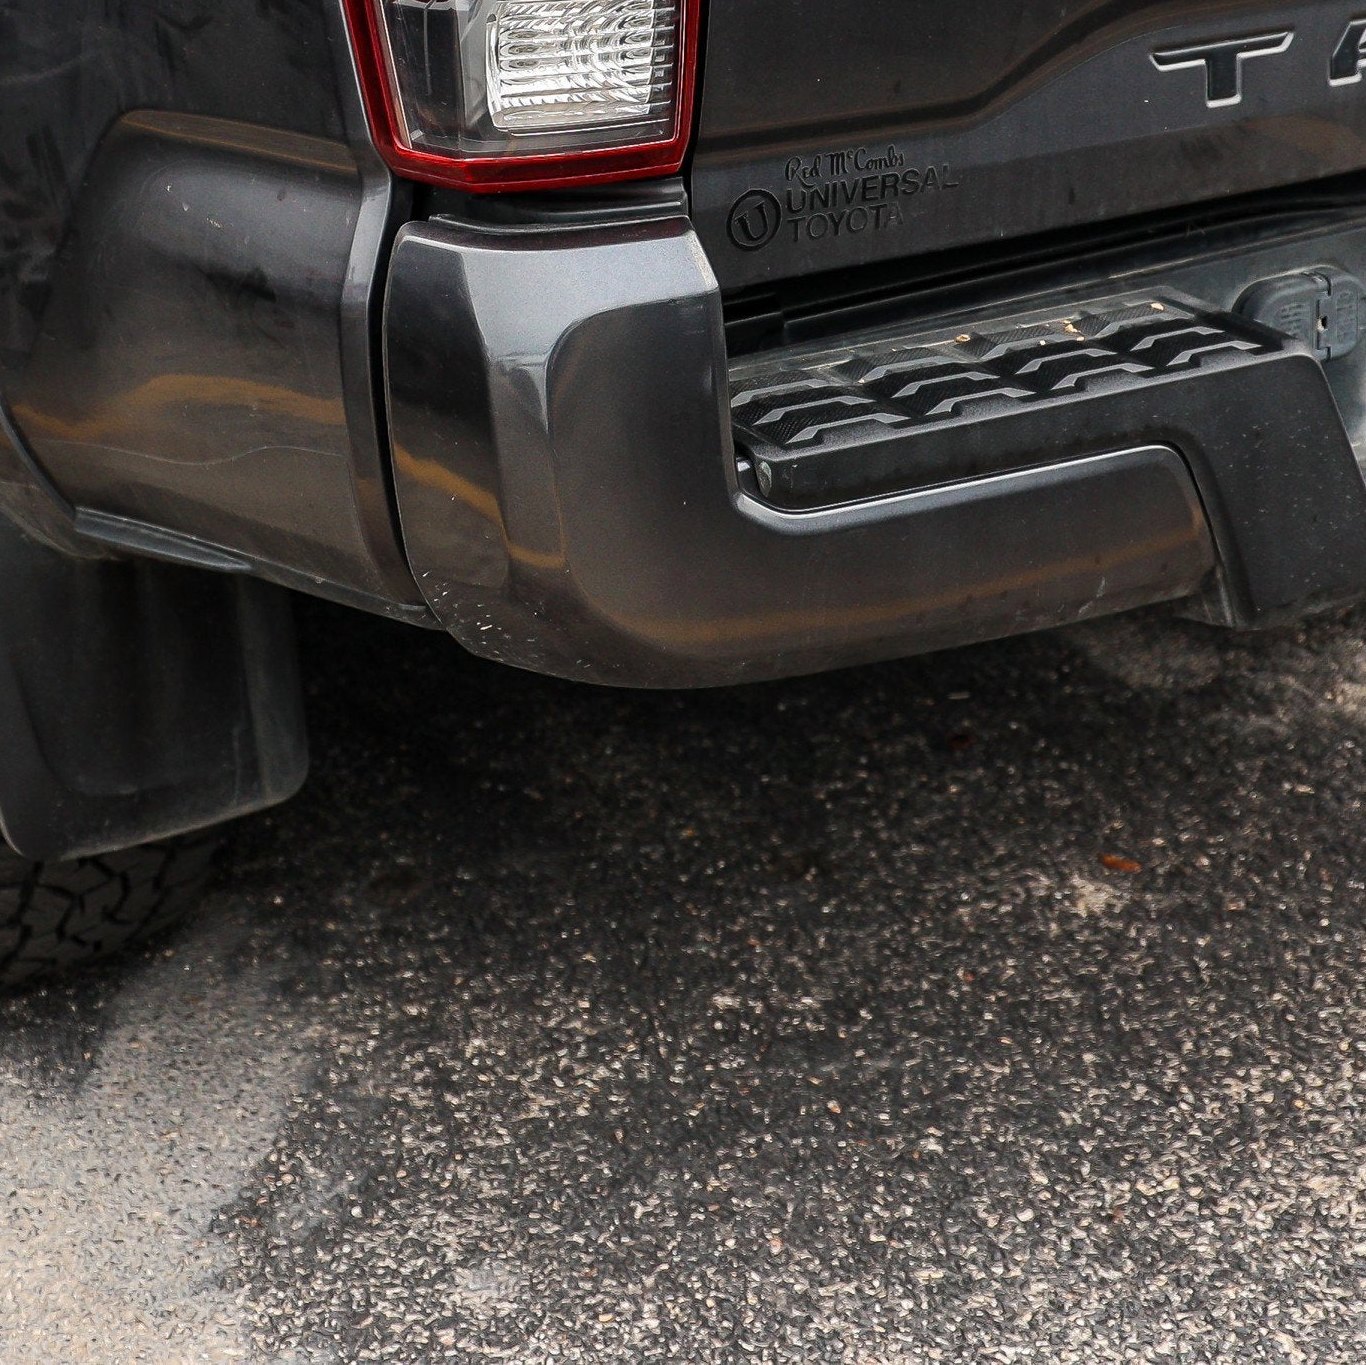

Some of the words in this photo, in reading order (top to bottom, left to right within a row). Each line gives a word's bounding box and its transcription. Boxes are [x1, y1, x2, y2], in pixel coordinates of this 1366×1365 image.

[785, 155, 823, 187] Red
[785, 163, 960, 214] UNIVERSAL
[786, 201, 905, 243] TOYOTA
